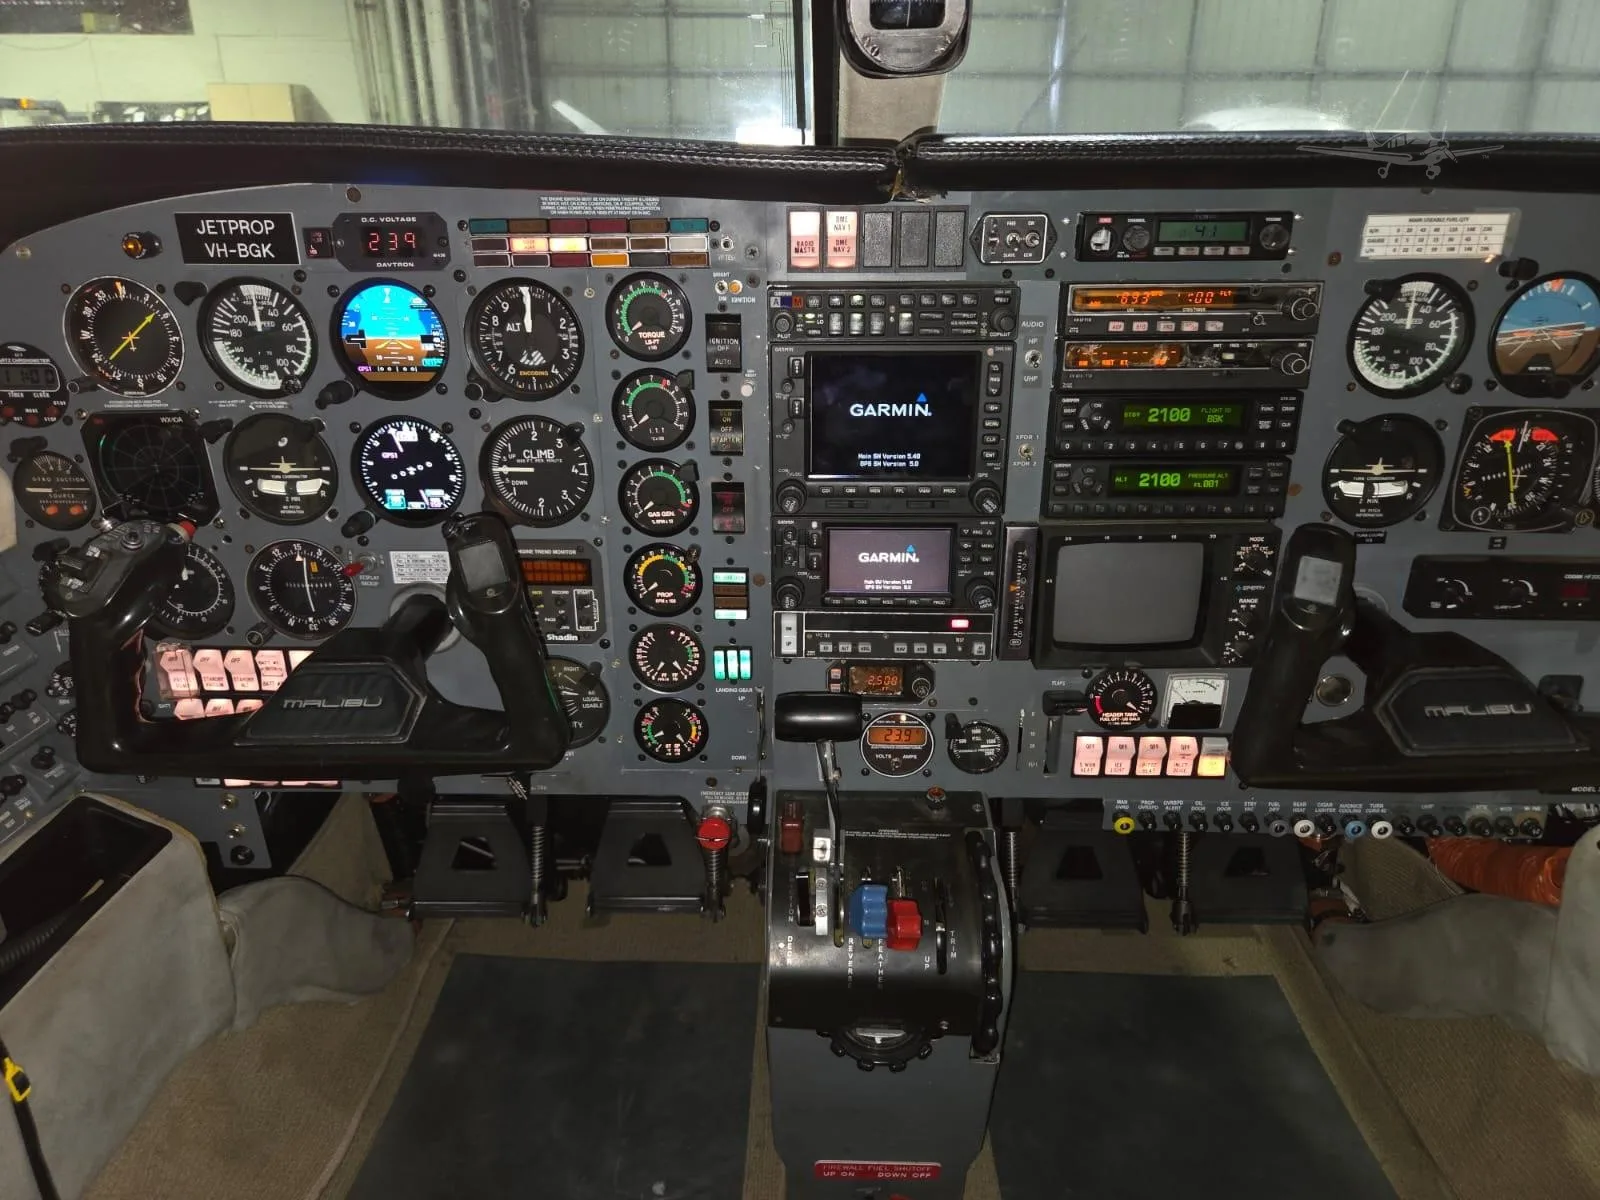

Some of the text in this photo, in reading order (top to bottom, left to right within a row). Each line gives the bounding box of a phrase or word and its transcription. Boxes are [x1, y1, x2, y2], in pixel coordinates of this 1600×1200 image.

[197, 219, 275, 234] JETPROP
[204, 244, 275, 258] VH-BGK
[502, 302, 509, 313] 9
[1420, 305, 1431, 314] 40
[268, 309, 280, 318] 40
[1381, 313, 1396, 321] 200
[234, 315, 248, 324] 200
[492, 315, 499, 326] 8
[560, 318, 567, 330] 2
[1429, 320, 1441, 329] 60
[282, 323, 293, 332] 60
[506, 322, 521, 332] ALT
[229, 329, 242, 338] 180
[286, 345, 297, 353] 80
[562, 348, 569, 359] 3
[276, 359, 289, 367] 100
[1409, 357, 1423, 365] 100
[508, 364, 515, 375] 6
[551, 364, 560, 375] 4
[850, 404, 929, 417] GARMIN
[1148, 407, 1191, 422] 2100
[531, 431, 538, 441] 2
[556, 439, 563, 448] 3
[523, 449, 555, 459] CLIMB
[572, 465, 578, 474] 4
[1139, 473, 1181, 487] 2100
[561, 490, 569, 499] 3
[538, 498, 545, 507] 2
[858, 552, 917, 563] GARMIN
[546, 633, 578, 641] Shadin
[283, 697, 382, 708] MALIBU
[1424, 704, 1534, 717] MALIBU
